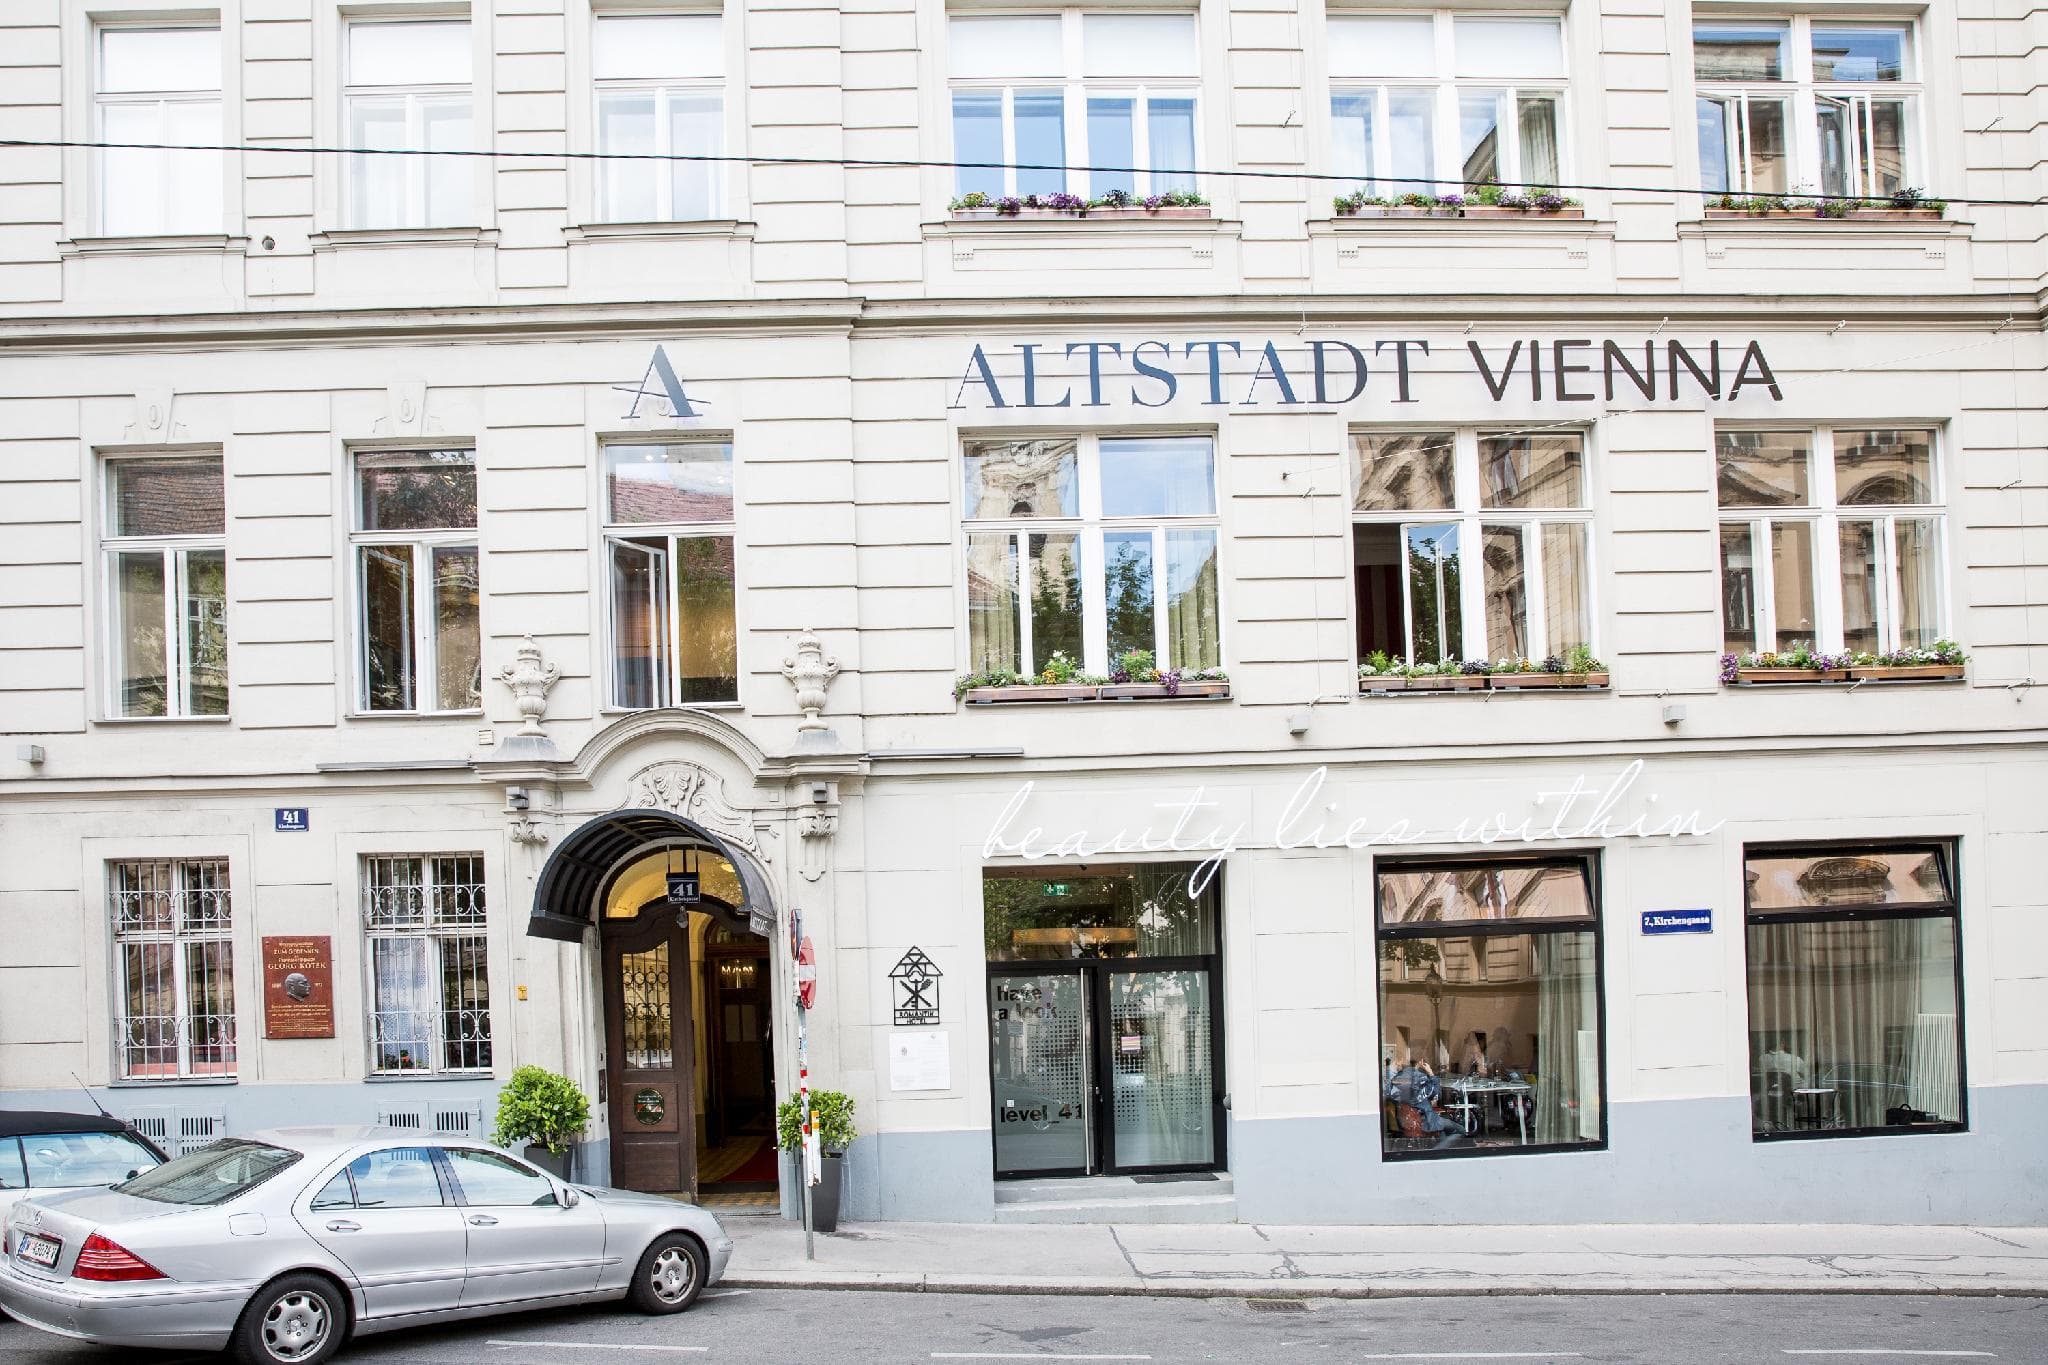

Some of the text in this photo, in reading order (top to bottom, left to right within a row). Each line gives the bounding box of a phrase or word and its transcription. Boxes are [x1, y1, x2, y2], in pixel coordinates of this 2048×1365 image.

[612, 343, 711, 418] A
[947, 339, 1783, 410] ALTSTADT VIENNA
[283, 810, 299, 823] 41
[982, 758, 1728, 899] beauty lies within
[672, 883, 693, 897] 41
[1653, 915, 1710, 926] Kirchengasse
[999, 1008, 1008, 1020] a
